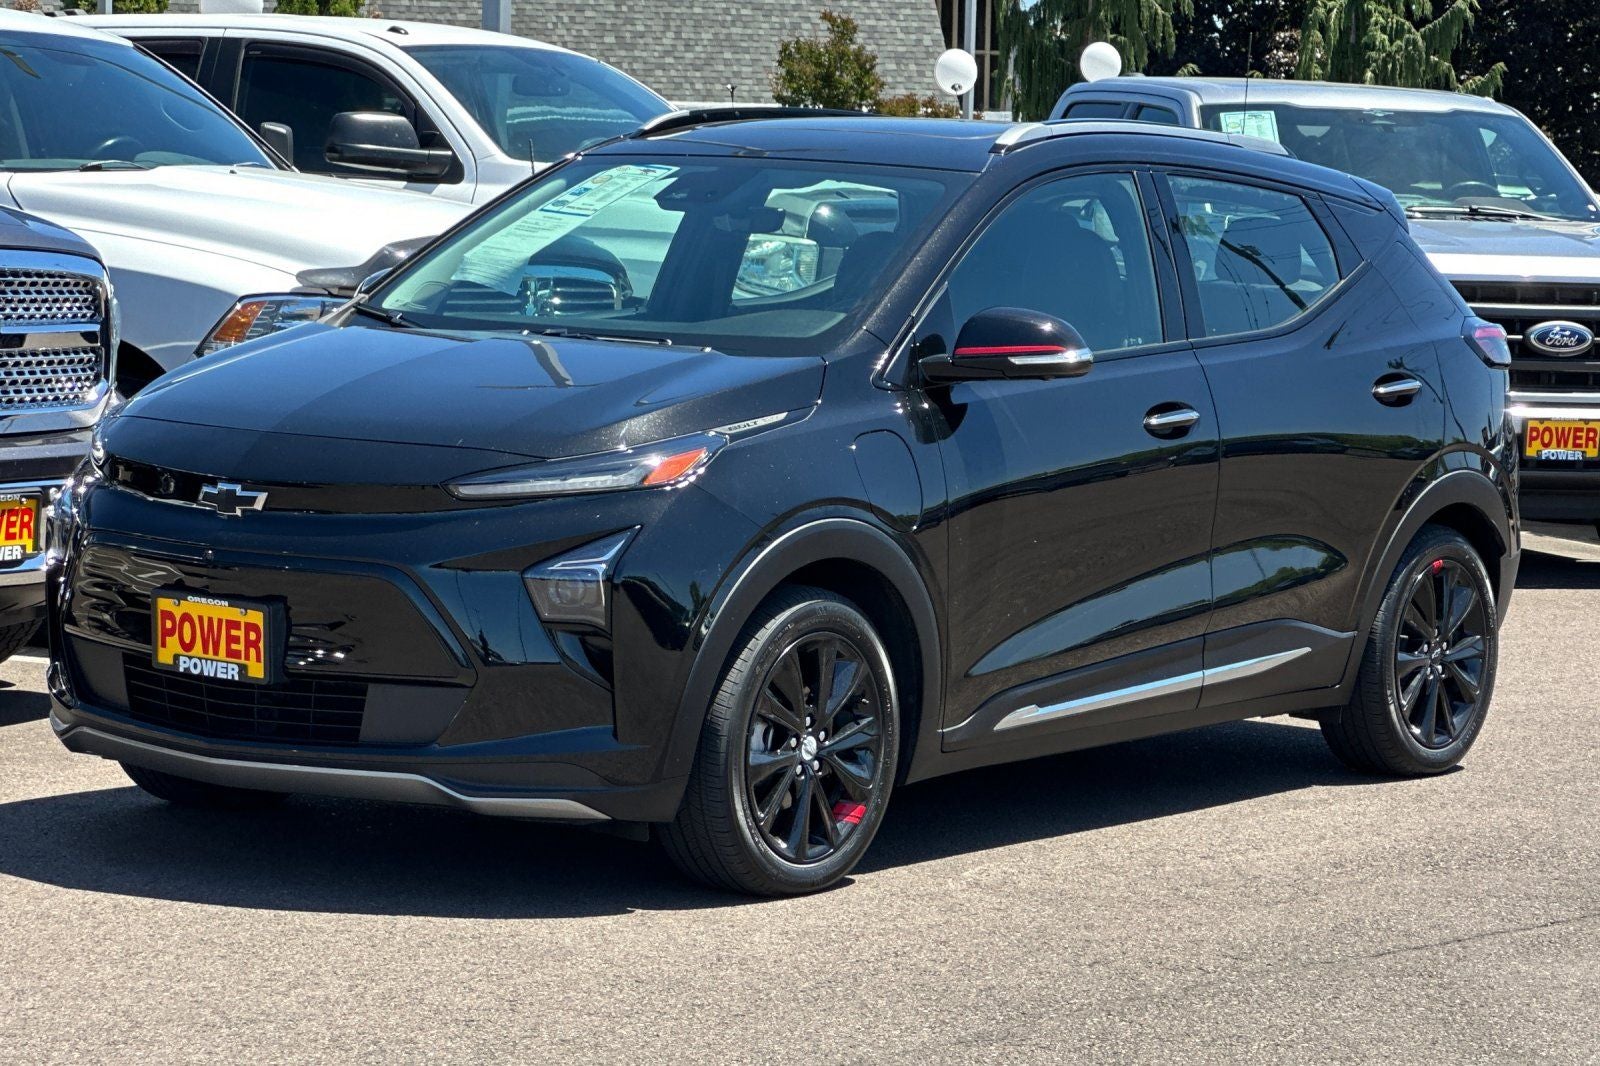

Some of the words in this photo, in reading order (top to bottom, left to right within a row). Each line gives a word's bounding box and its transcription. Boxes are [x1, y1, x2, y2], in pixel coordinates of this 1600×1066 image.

[1545, 326, 1579, 346] Ford
[1528, 426, 1599, 449] POWER
[1541, 450, 1583, 461] POWER
[187, 595, 229, 606] OREGON
[160, 609, 262, 663] POWER
[179, 656, 239, 680] POWER
